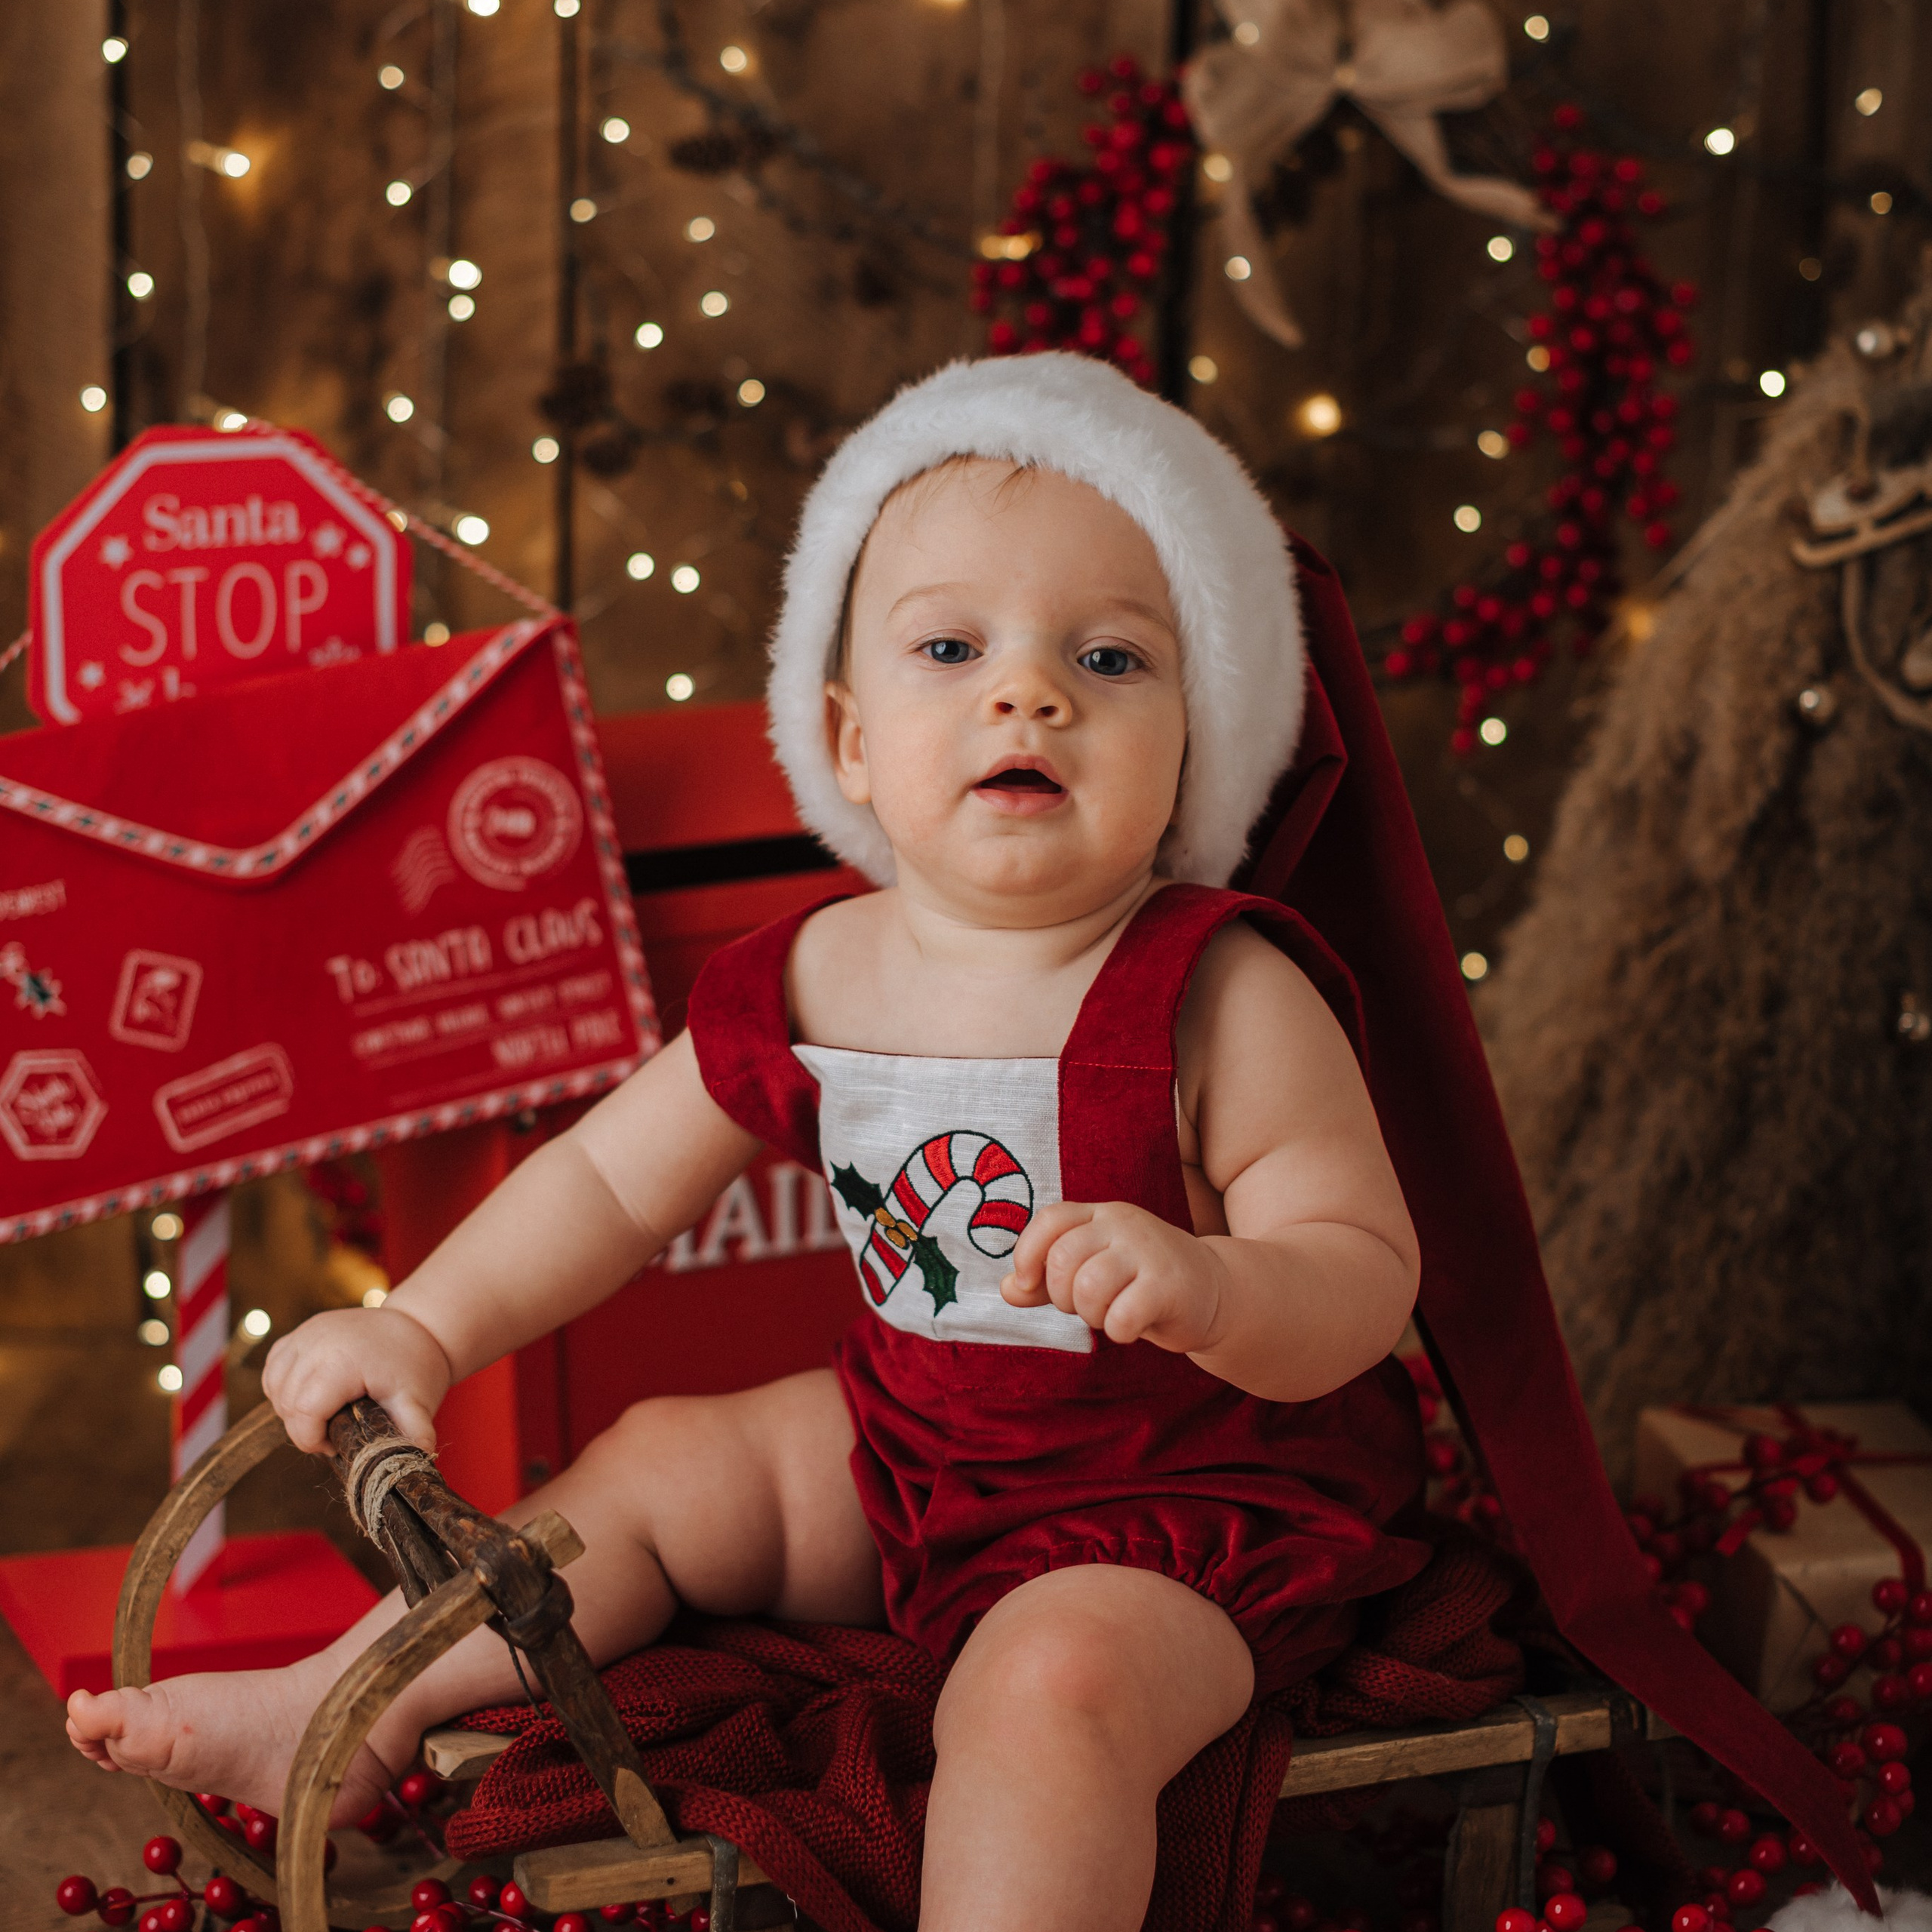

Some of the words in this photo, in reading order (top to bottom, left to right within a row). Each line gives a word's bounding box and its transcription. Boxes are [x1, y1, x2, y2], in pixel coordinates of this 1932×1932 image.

[143, 493, 303, 552] Santa
[118, 559, 330, 667] STOP
[649, 1161, 851, 1273] AIL
